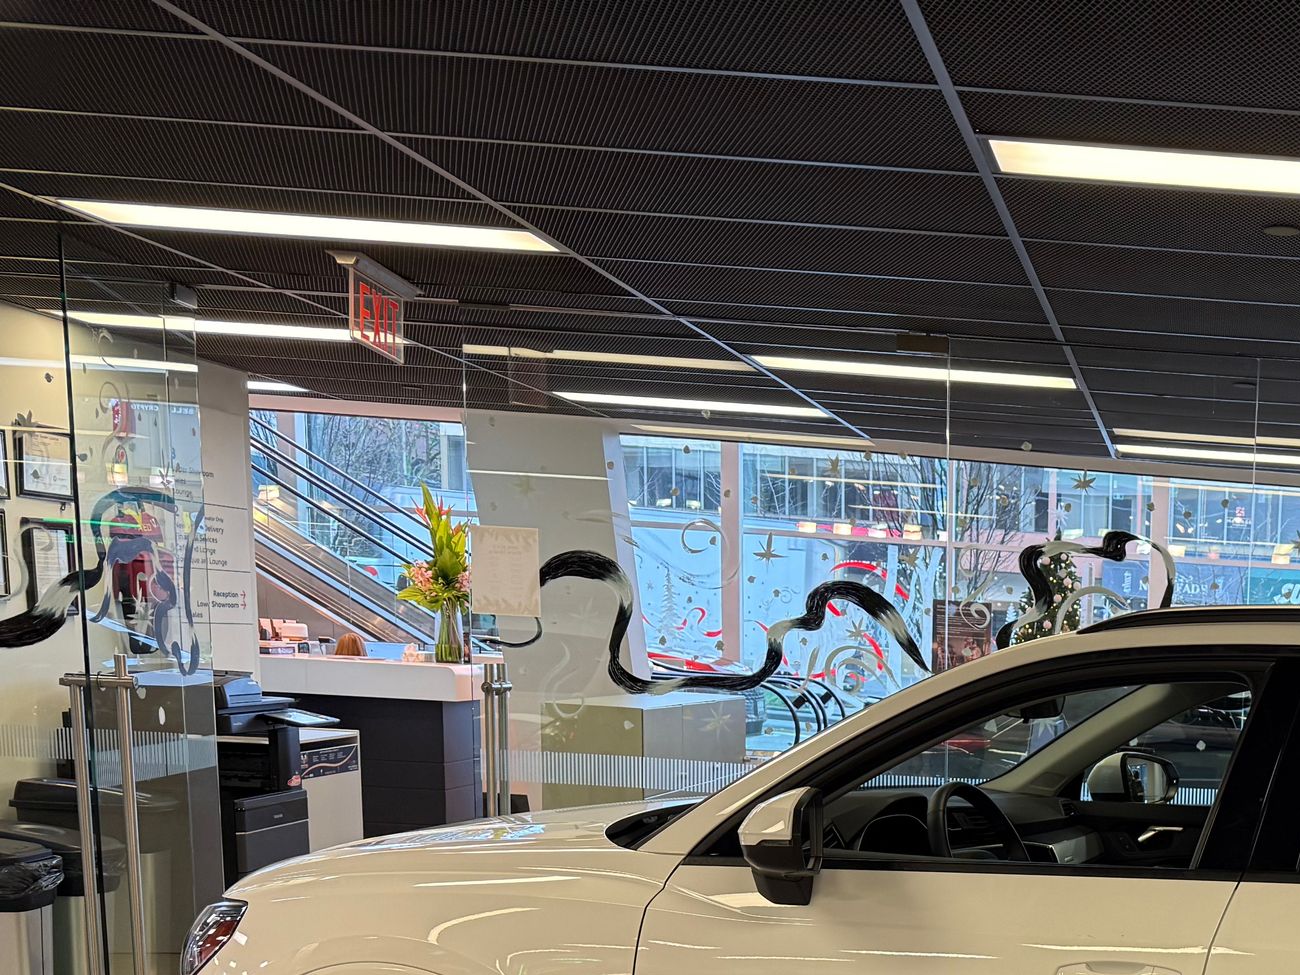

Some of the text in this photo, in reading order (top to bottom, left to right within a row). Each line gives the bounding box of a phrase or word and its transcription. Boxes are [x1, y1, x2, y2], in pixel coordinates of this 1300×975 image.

[359, 281, 399, 357] EXIT
[213, 589, 239, 599] Reception
[211, 600, 239, 609] Showroom
